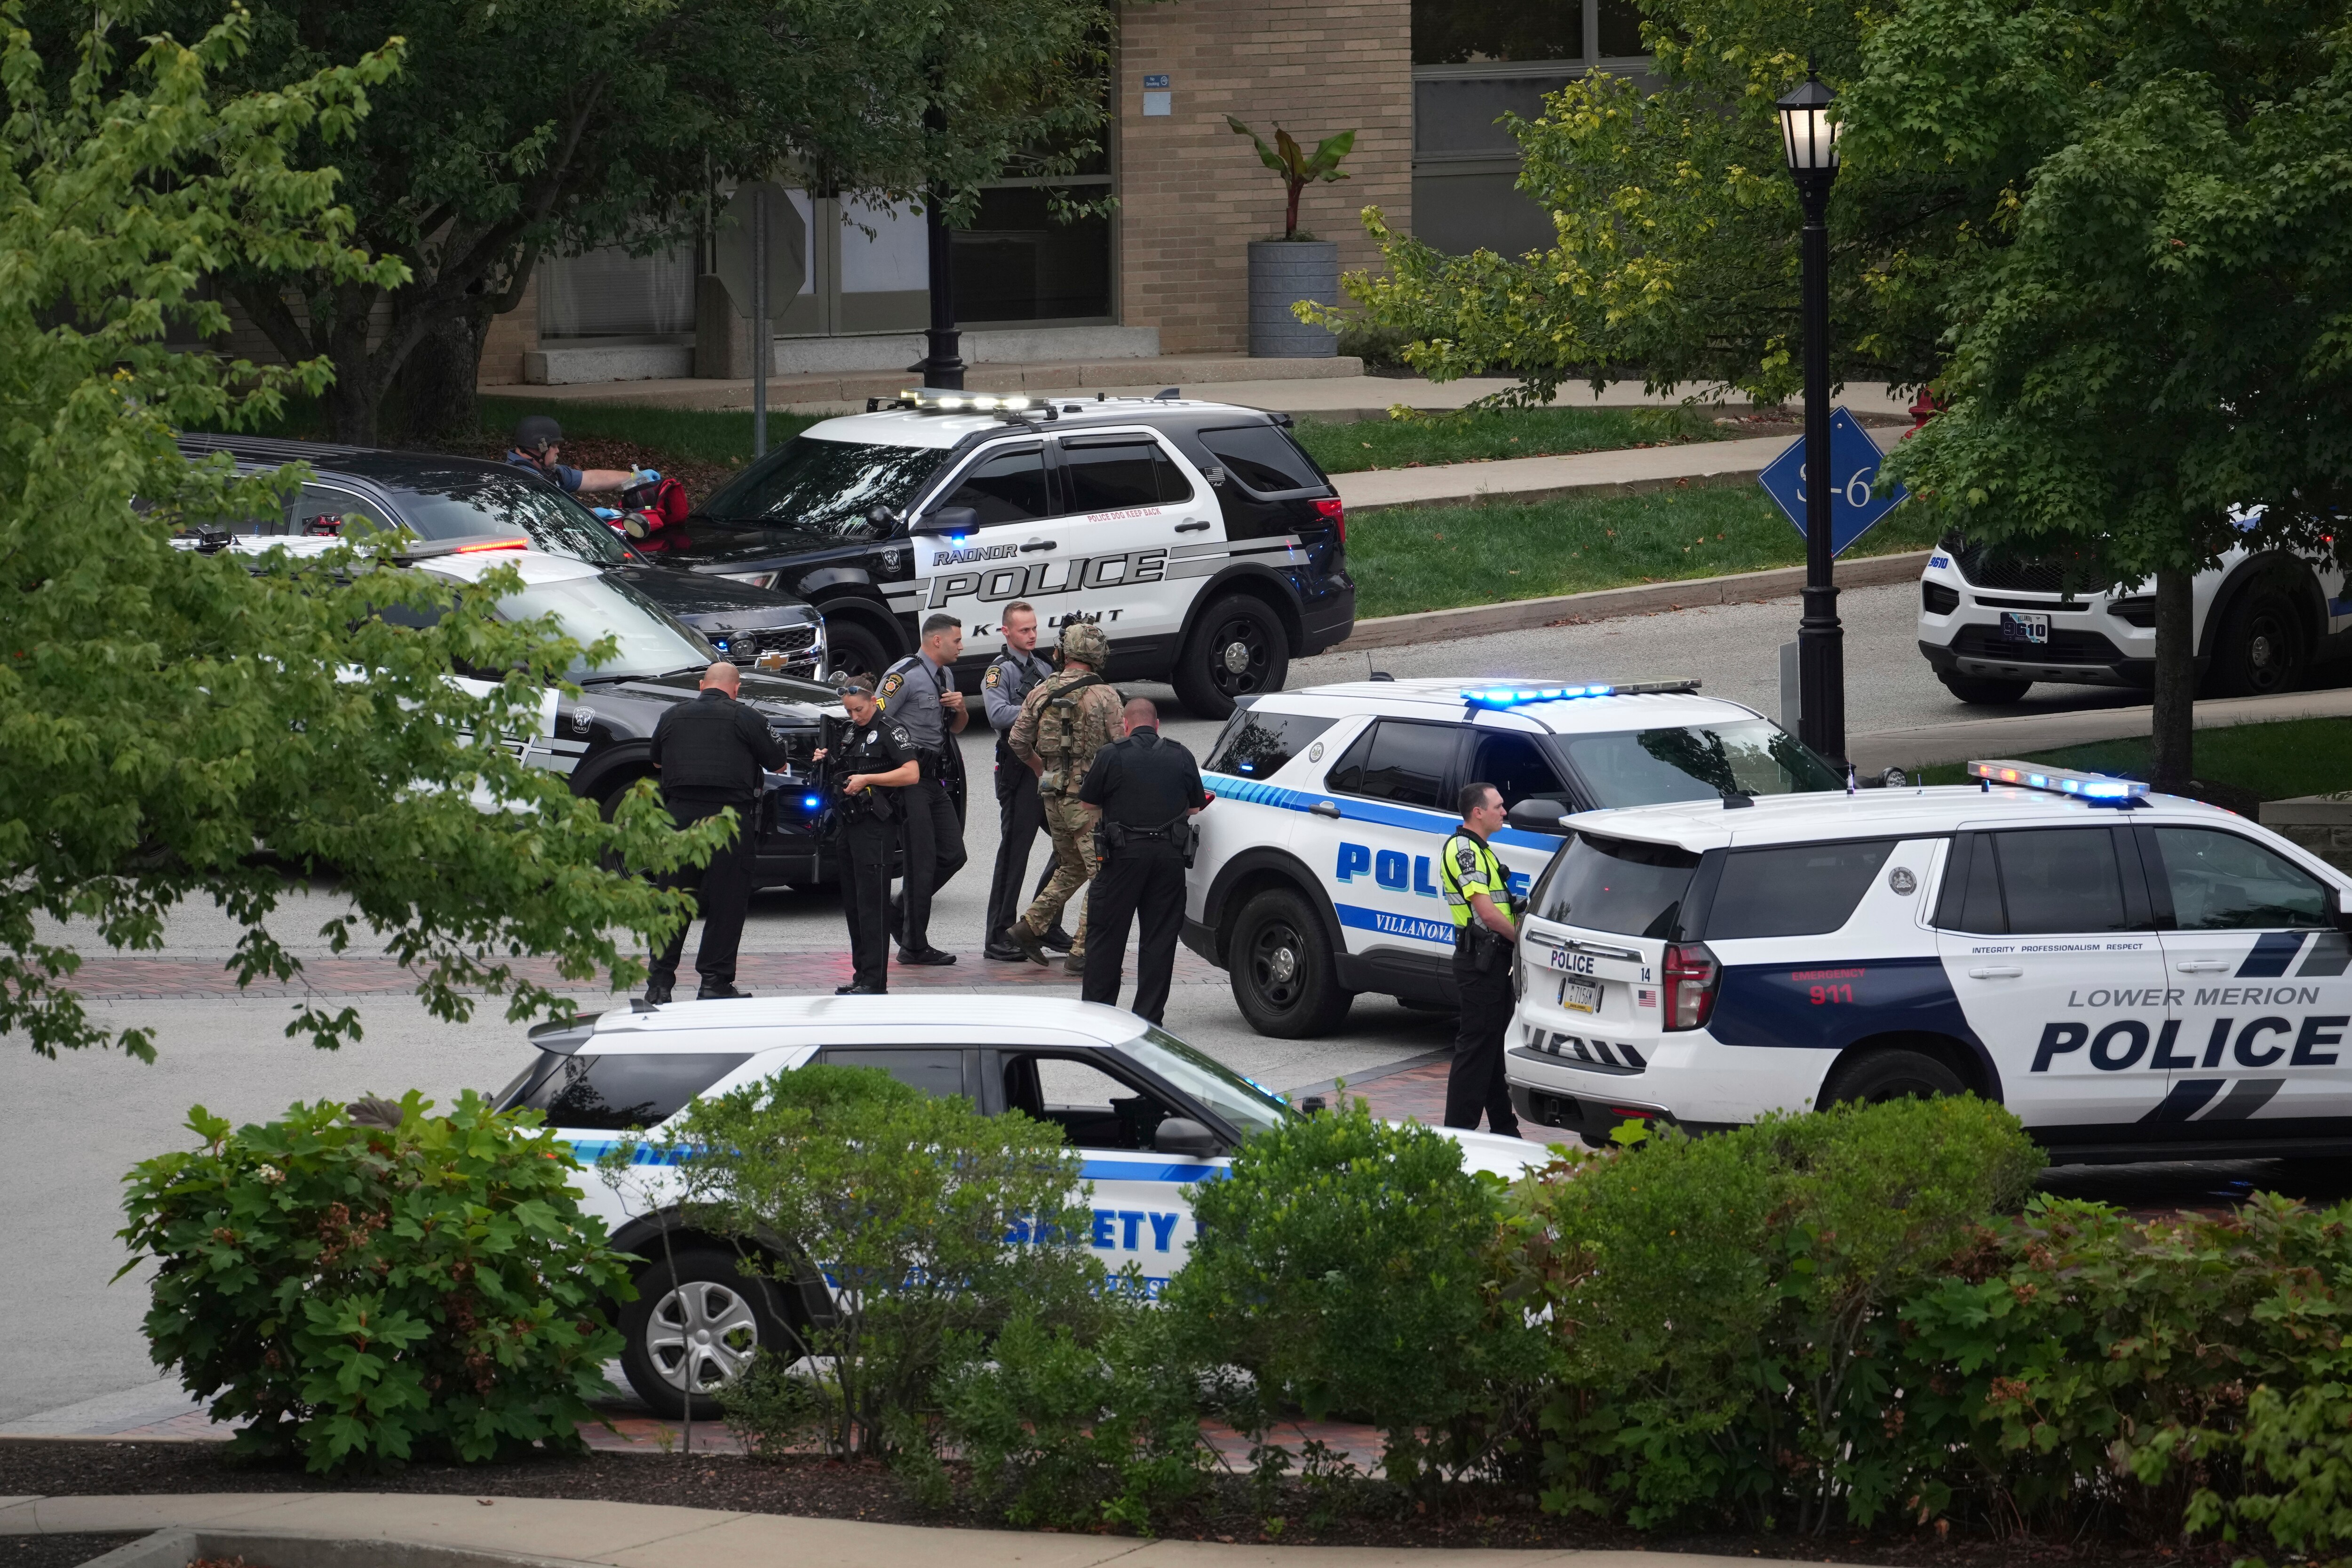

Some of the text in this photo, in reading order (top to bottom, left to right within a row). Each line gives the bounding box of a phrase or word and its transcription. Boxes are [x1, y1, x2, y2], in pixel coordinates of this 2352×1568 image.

[1087, 513, 1111, 522] POLICE
[1125, 509, 1142, 518] KEEP
[1143, 508, 1162, 516] BACK
[933, 543, 1018, 566] RADNOR
[1928, 557, 1948, 569] 9610
[928, 548, 1168, 610] POLICE
[1048, 609, 1123, 629] UIT
[2004, 621, 2046, 637] 9610
[1457, 849, 1474, 858] RADNOR
[1336, 842, 1531, 899] POLE
[1376, 914, 1453, 941] VILLANOVA
[1551, 950, 1651, 982] POLICE 14
[1791, 968, 1866, 981] EMERGENCY
[1810, 984, 1853, 1005] 911
[2068, 987, 2320, 1008] LOWER MERION
[2029, 1015, 2352, 1074] POLICE
